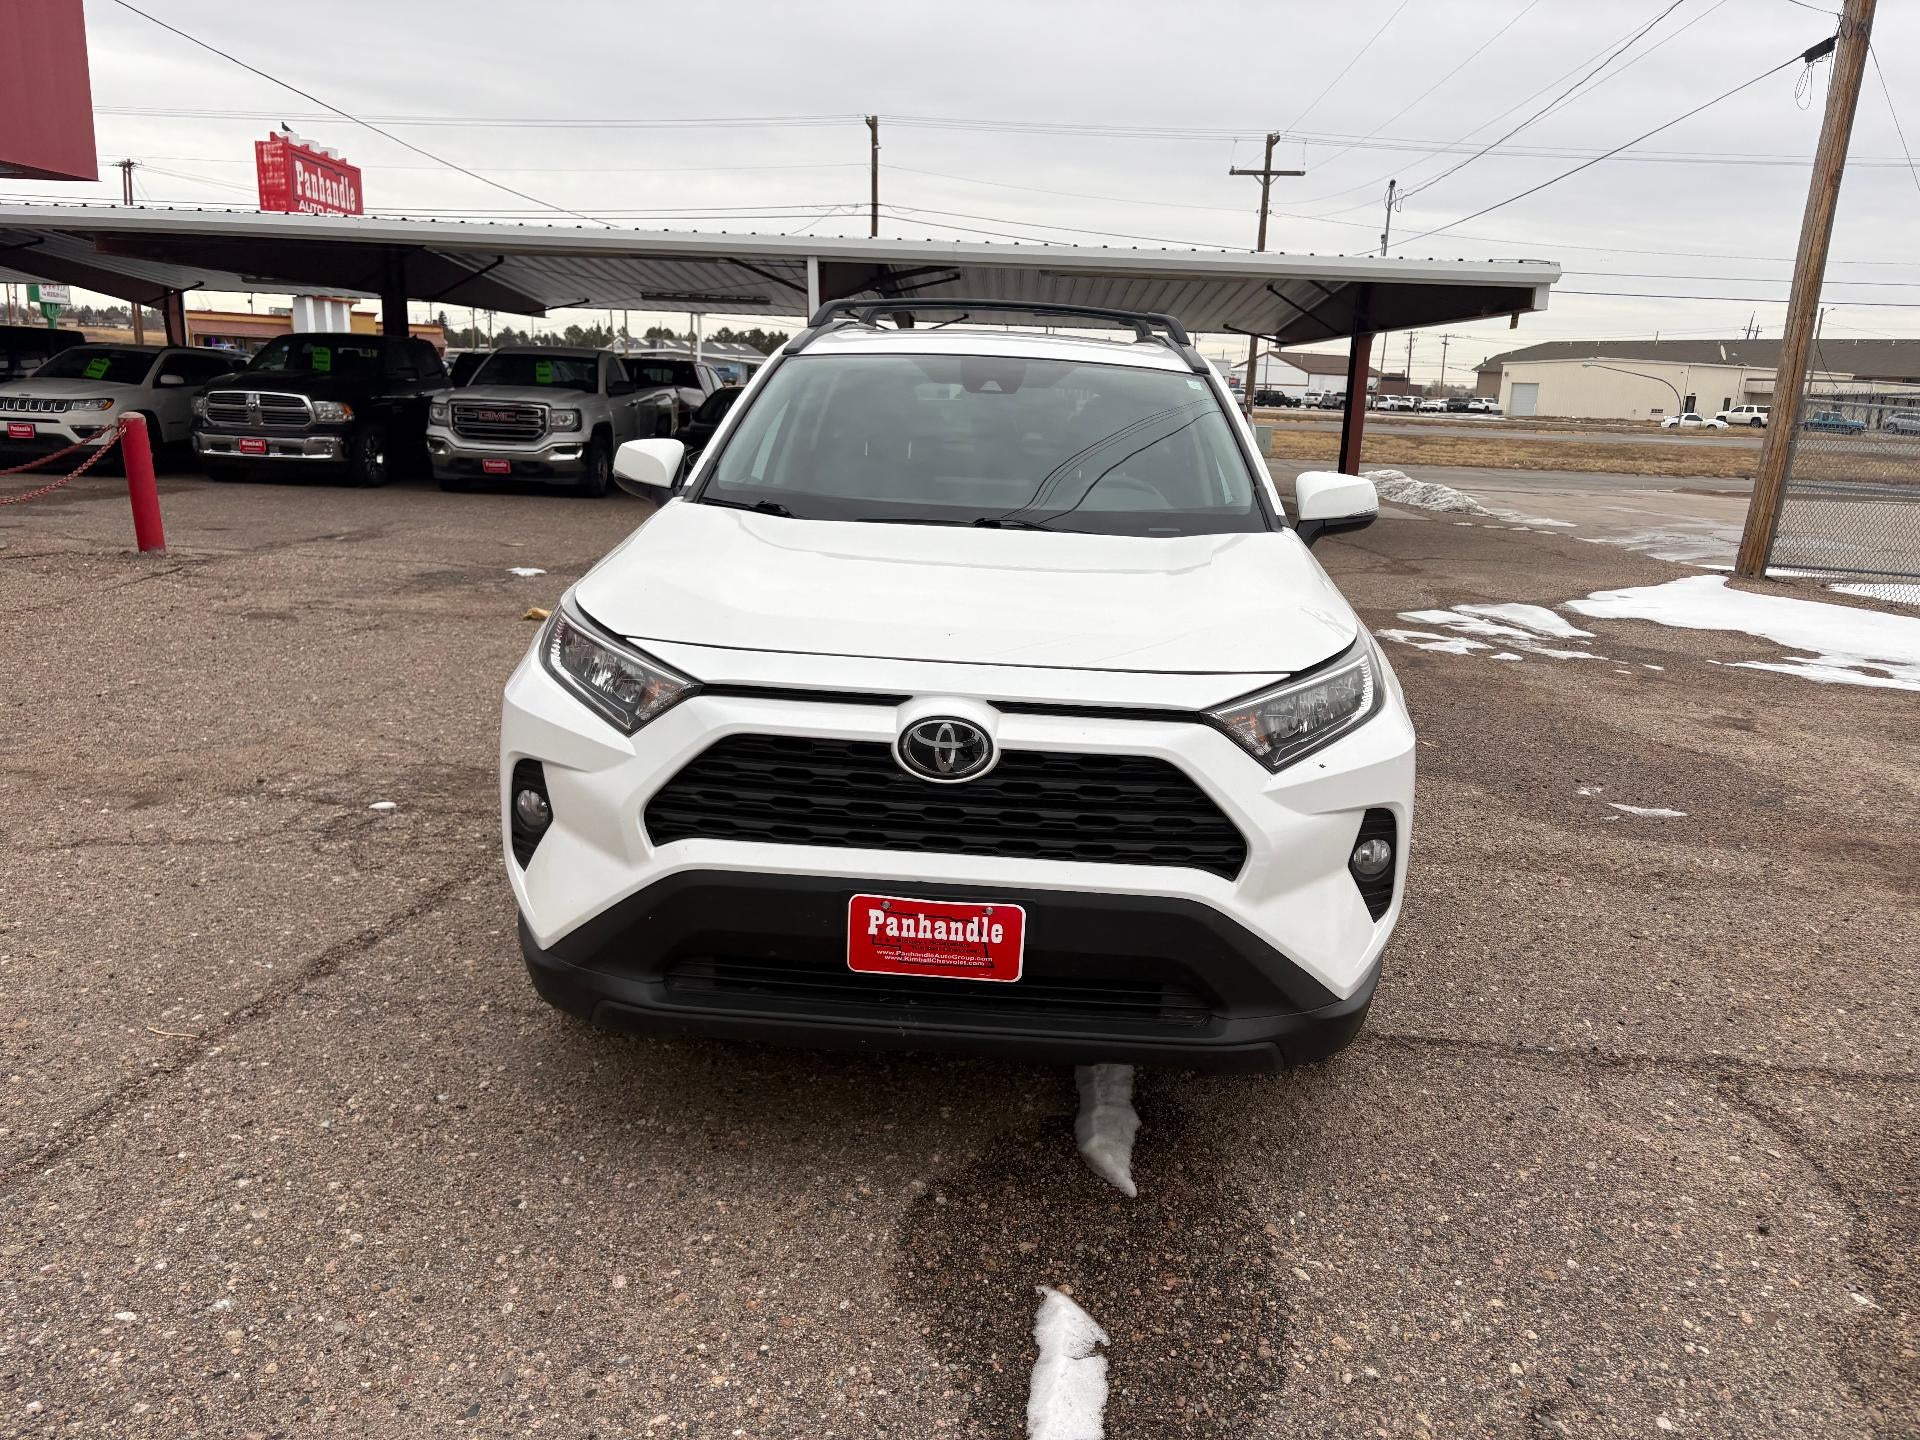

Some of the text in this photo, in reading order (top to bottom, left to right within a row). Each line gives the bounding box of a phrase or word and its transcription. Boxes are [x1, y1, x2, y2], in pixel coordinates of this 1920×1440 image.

[295, 160, 356, 212] Panhandle
[299, 200, 324, 214] AUTO
[479, 410, 516, 421] GMC
[867, 909, 1004, 944] Panhandle
[876, 950, 993, 962] www.PanhandleAutoGroup.com
[884, 955, 985, 966] www.KimballChevrolet.com
